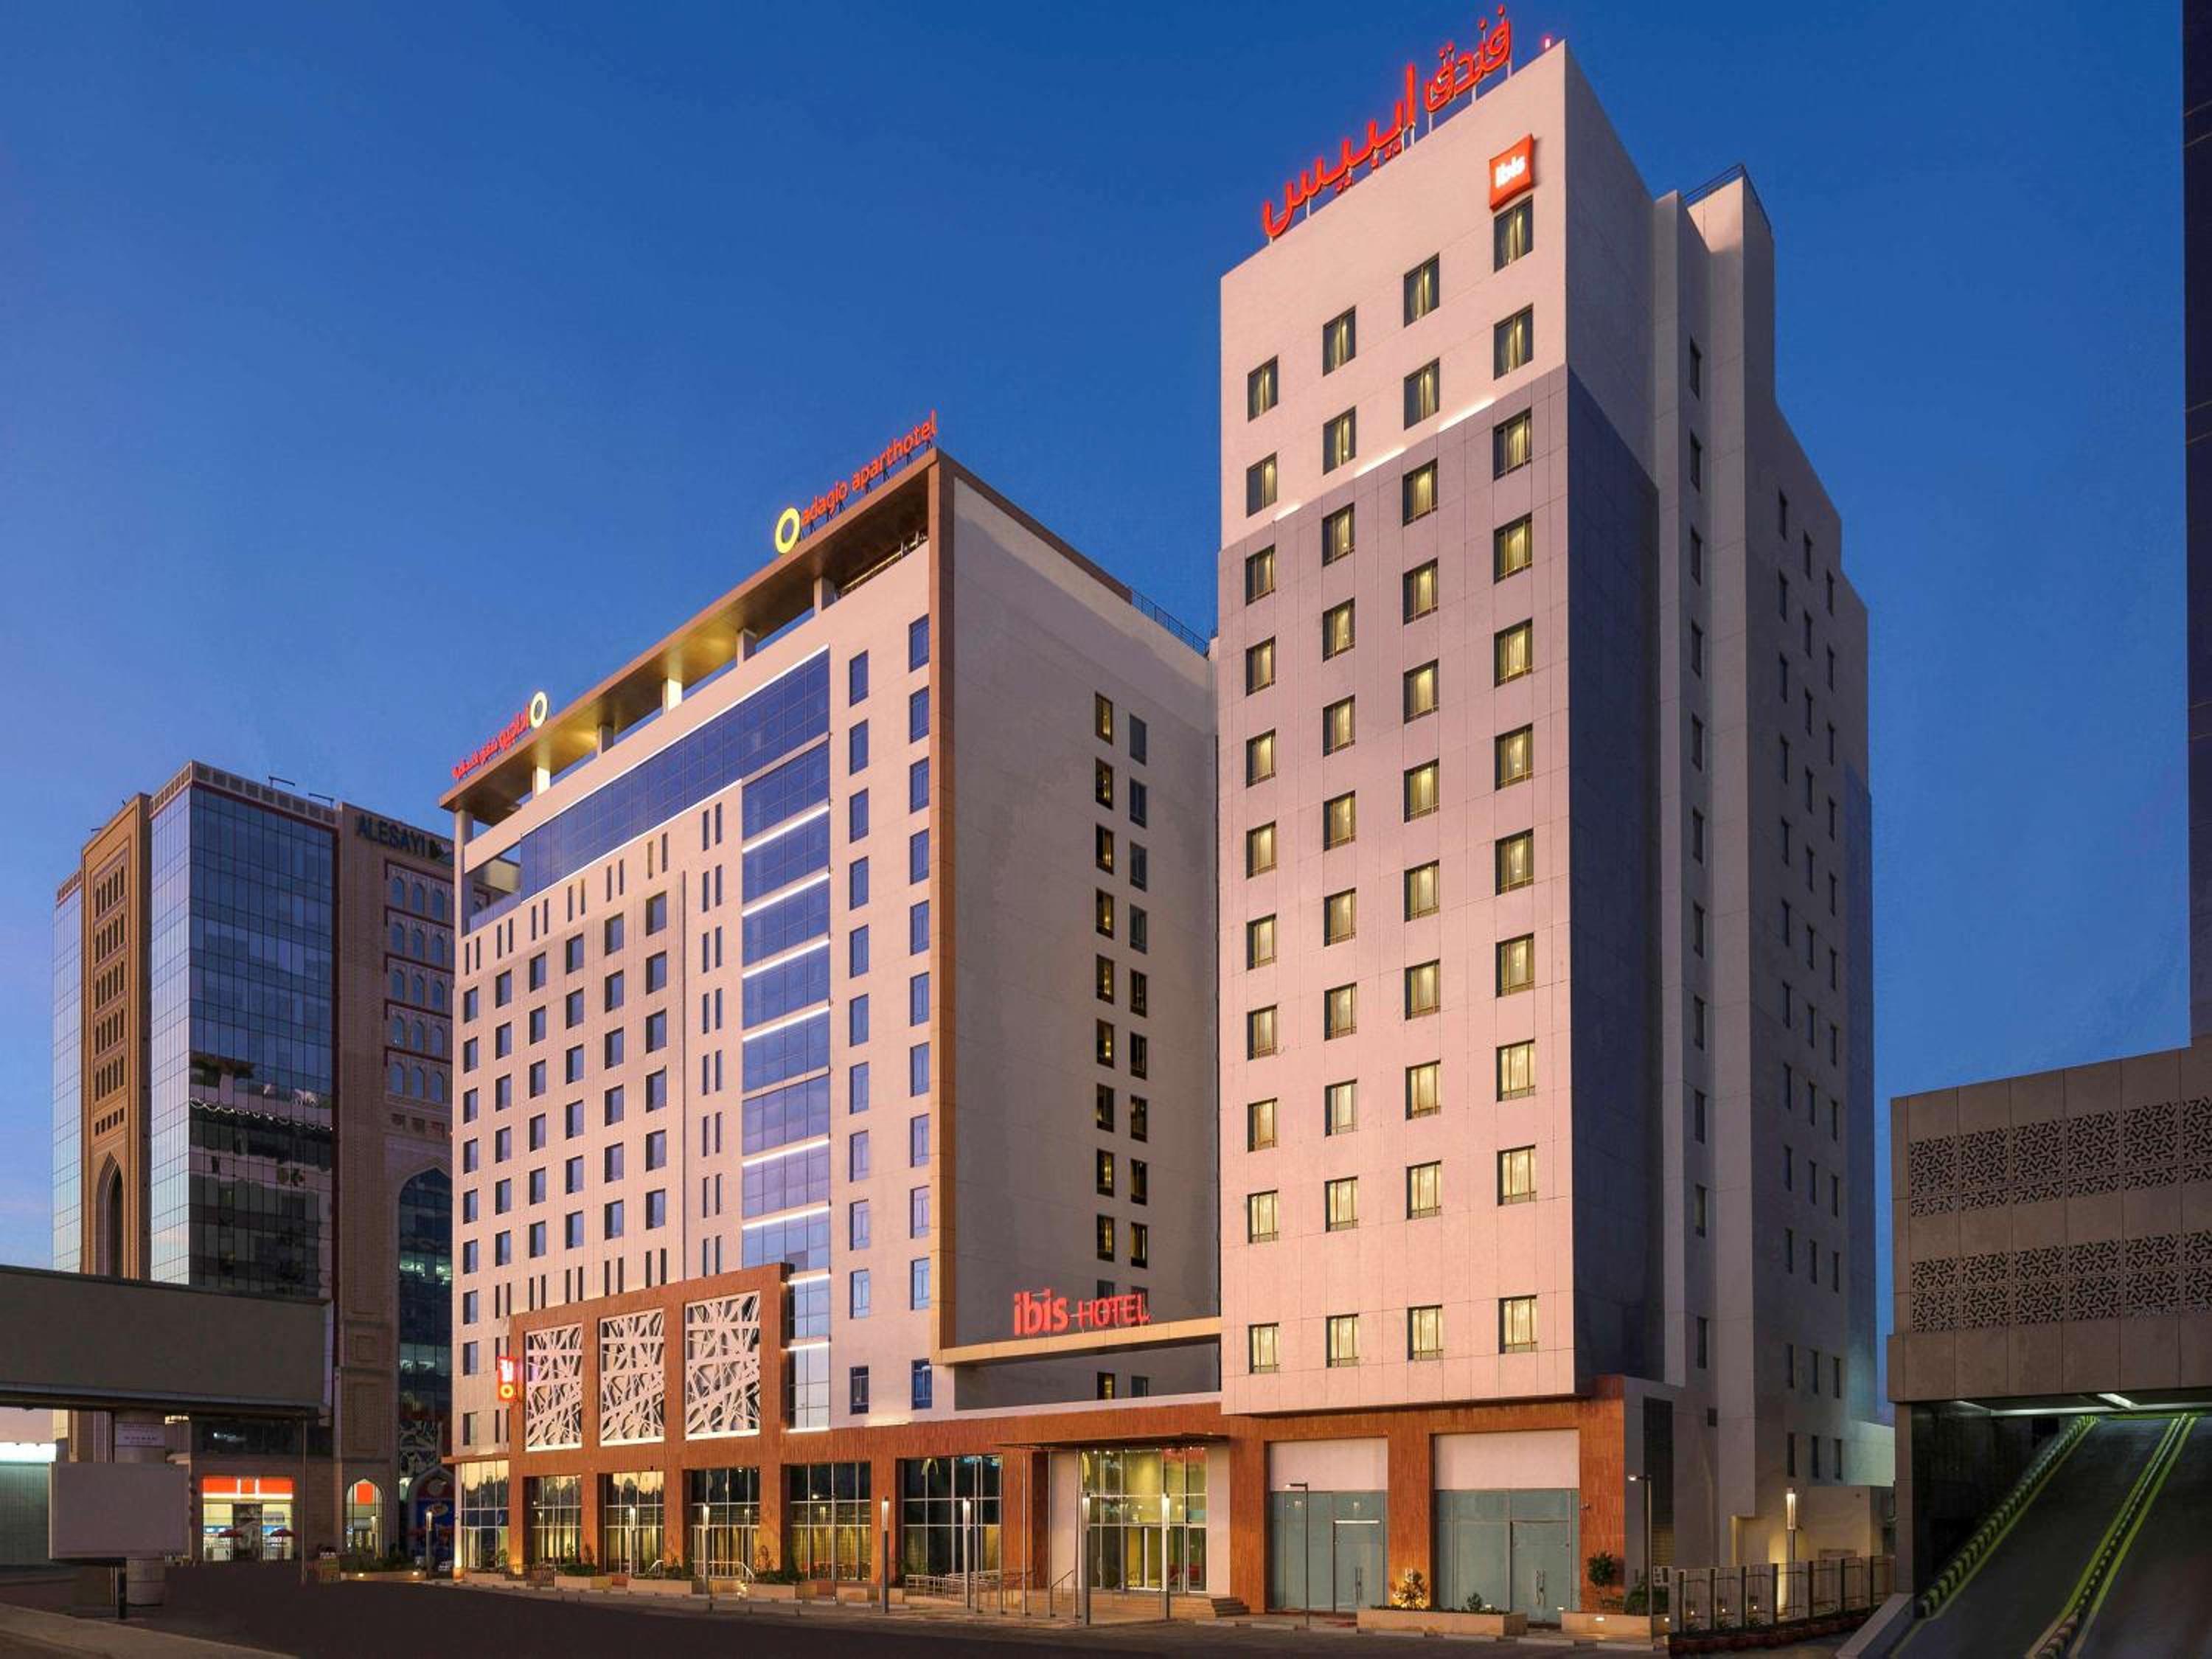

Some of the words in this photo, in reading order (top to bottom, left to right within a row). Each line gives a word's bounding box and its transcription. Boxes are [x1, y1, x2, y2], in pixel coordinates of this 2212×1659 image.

[1424, 5, 1510, 112] فندق
[801, 481, 848, 526] adagio
[852, 410, 937, 489] aparthotel
[1014, 1289, 1069, 1336] ibis
[1078, 1293, 1150, 1328] HOTEL
